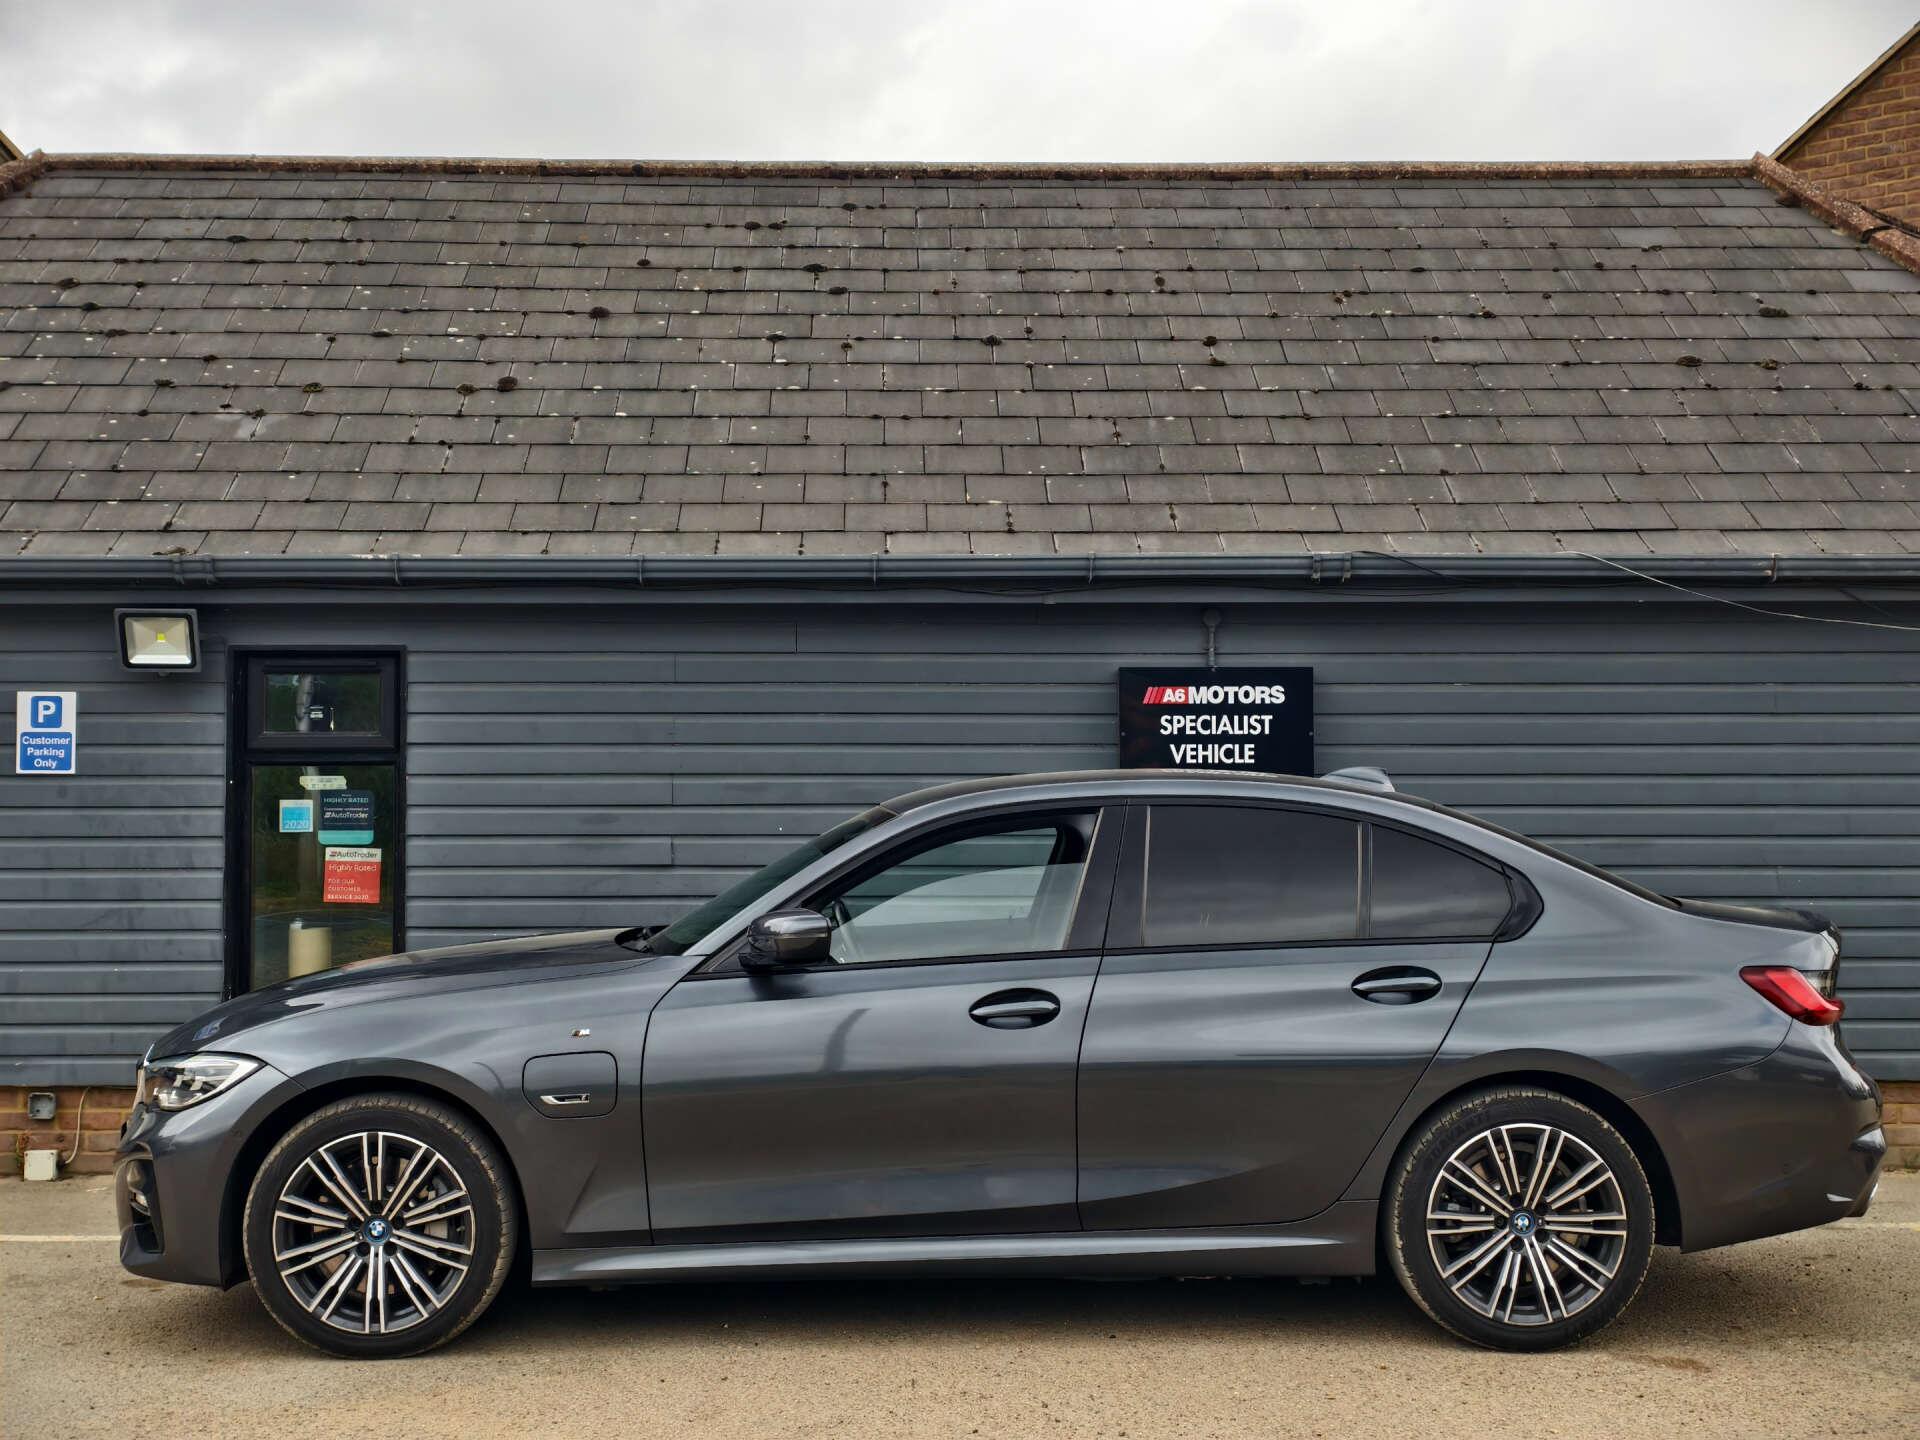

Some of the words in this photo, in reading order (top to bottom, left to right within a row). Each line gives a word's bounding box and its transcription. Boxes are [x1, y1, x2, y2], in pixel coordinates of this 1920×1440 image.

[1162, 688, 1187, 703] A6
[1188, 685, 1286, 704] MOTORS
[38, 700, 56, 723] P
[1159, 714, 1273, 735] SPECIALIST
[22, 736, 71, 745] Customer
[27, 747, 65, 758] Parking
[1169, 743, 1255, 764] VEHICLE
[33, 758, 57, 769] Only
[328, 863, 352, 872] Highly
[353, 864, 377, 872] Rated
